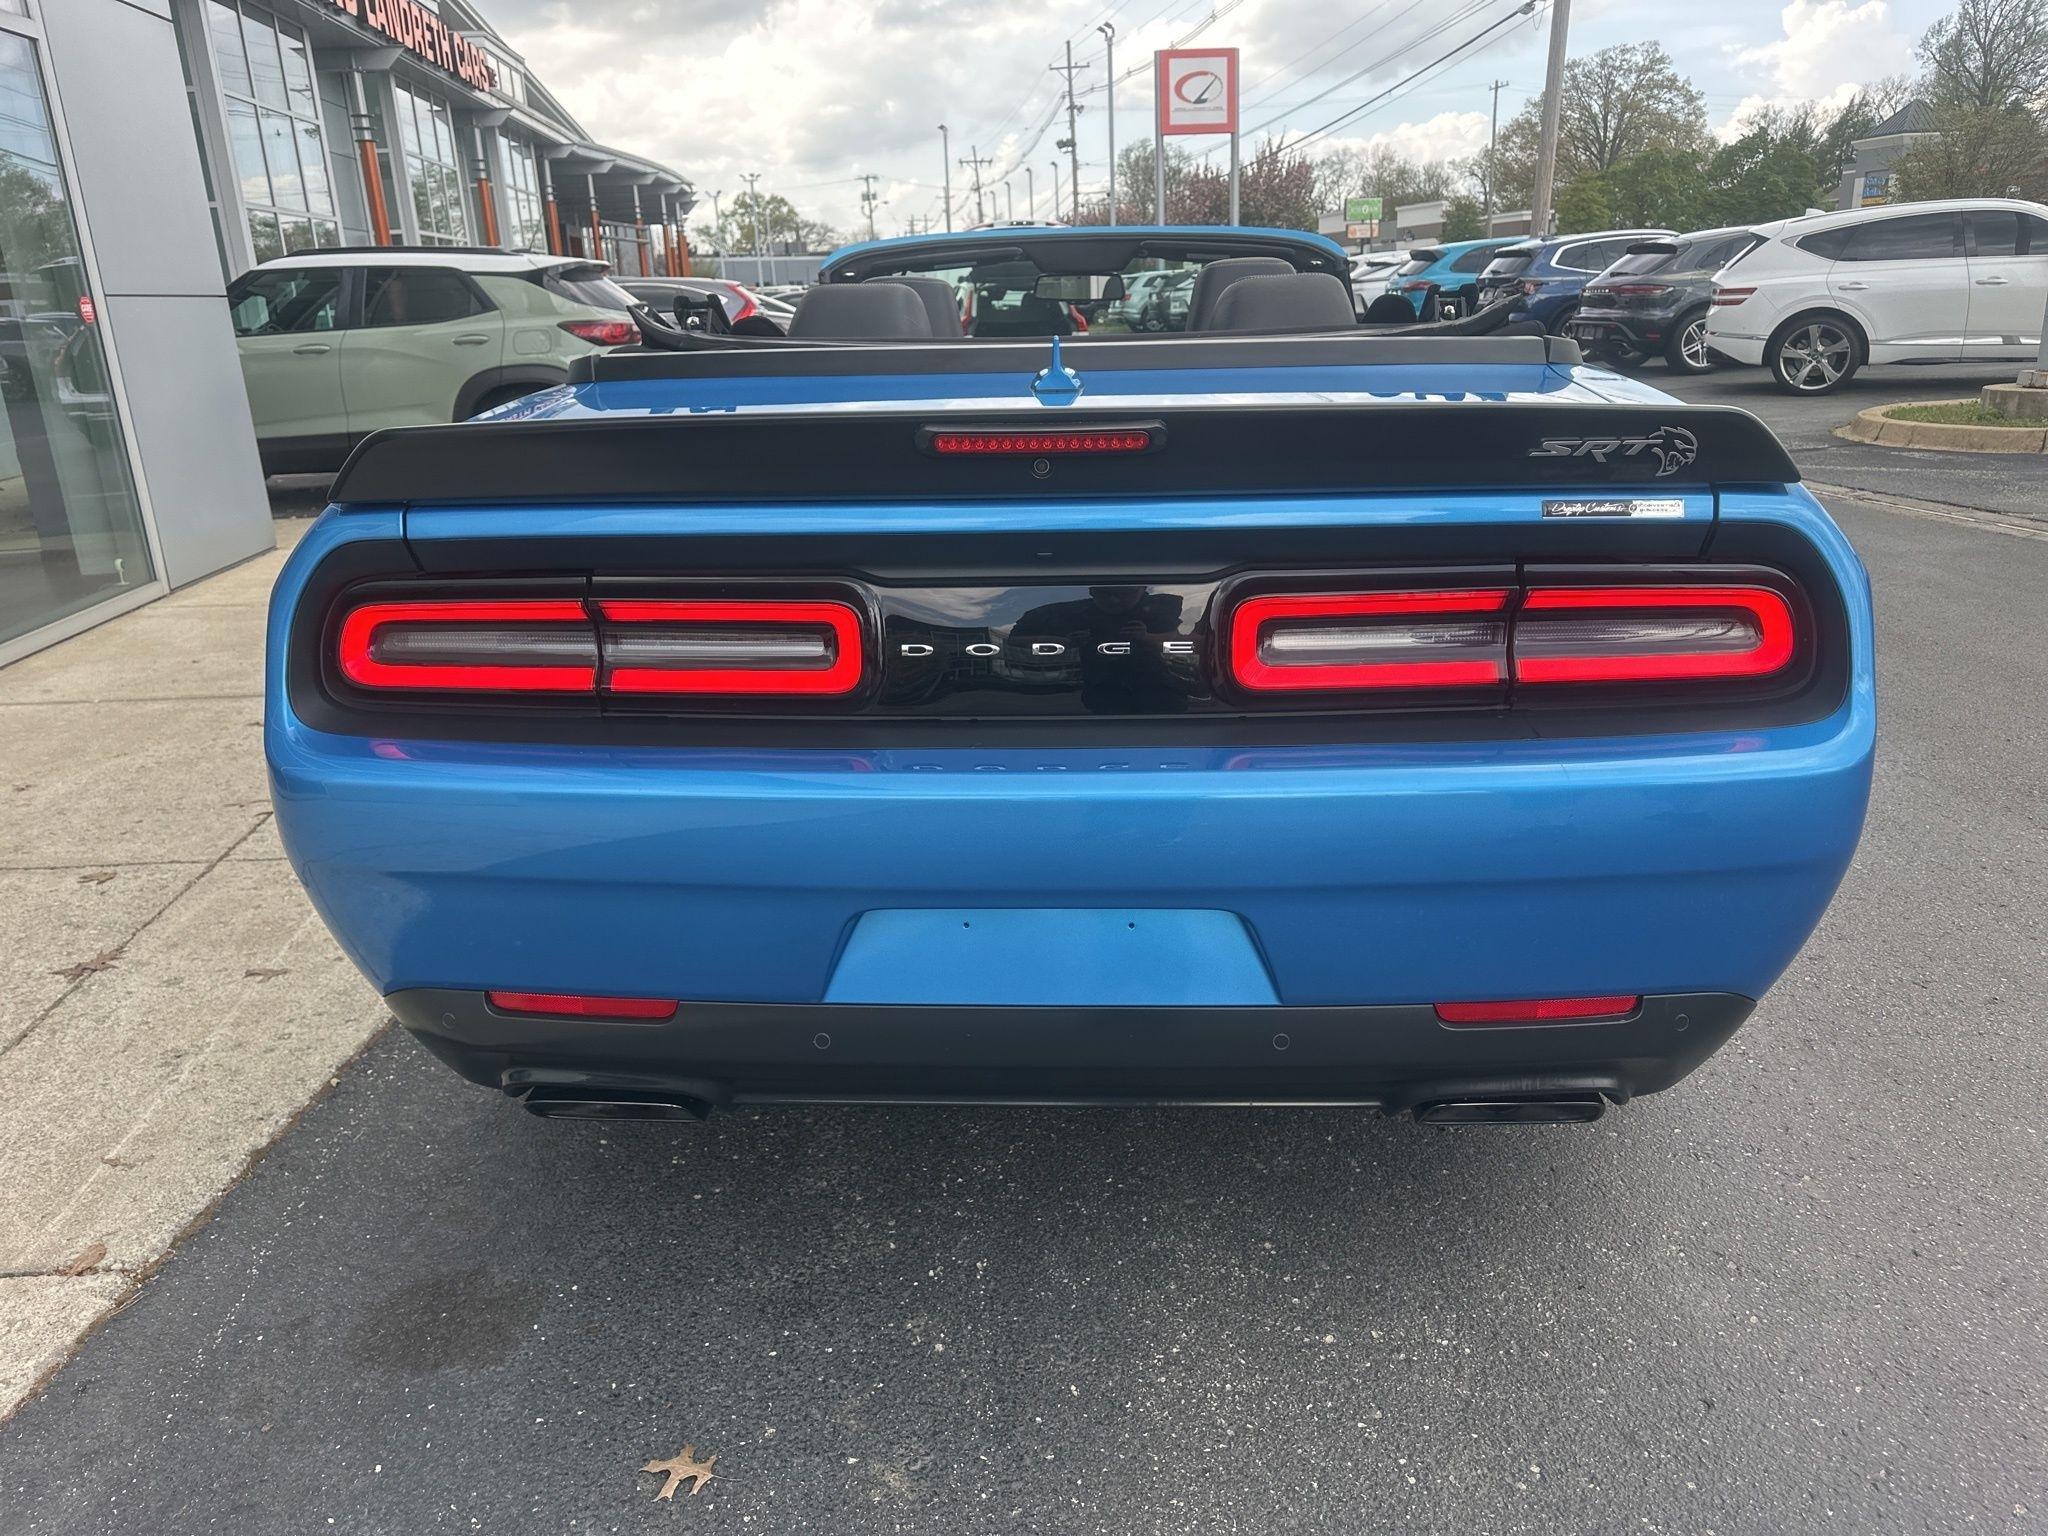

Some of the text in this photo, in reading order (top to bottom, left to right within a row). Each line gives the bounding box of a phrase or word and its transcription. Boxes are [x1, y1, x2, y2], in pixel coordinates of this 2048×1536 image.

[453, 31, 490, 92] CARS
[1529, 439, 1664, 463] SRT
[901, 641, 1194, 656] DODGE
